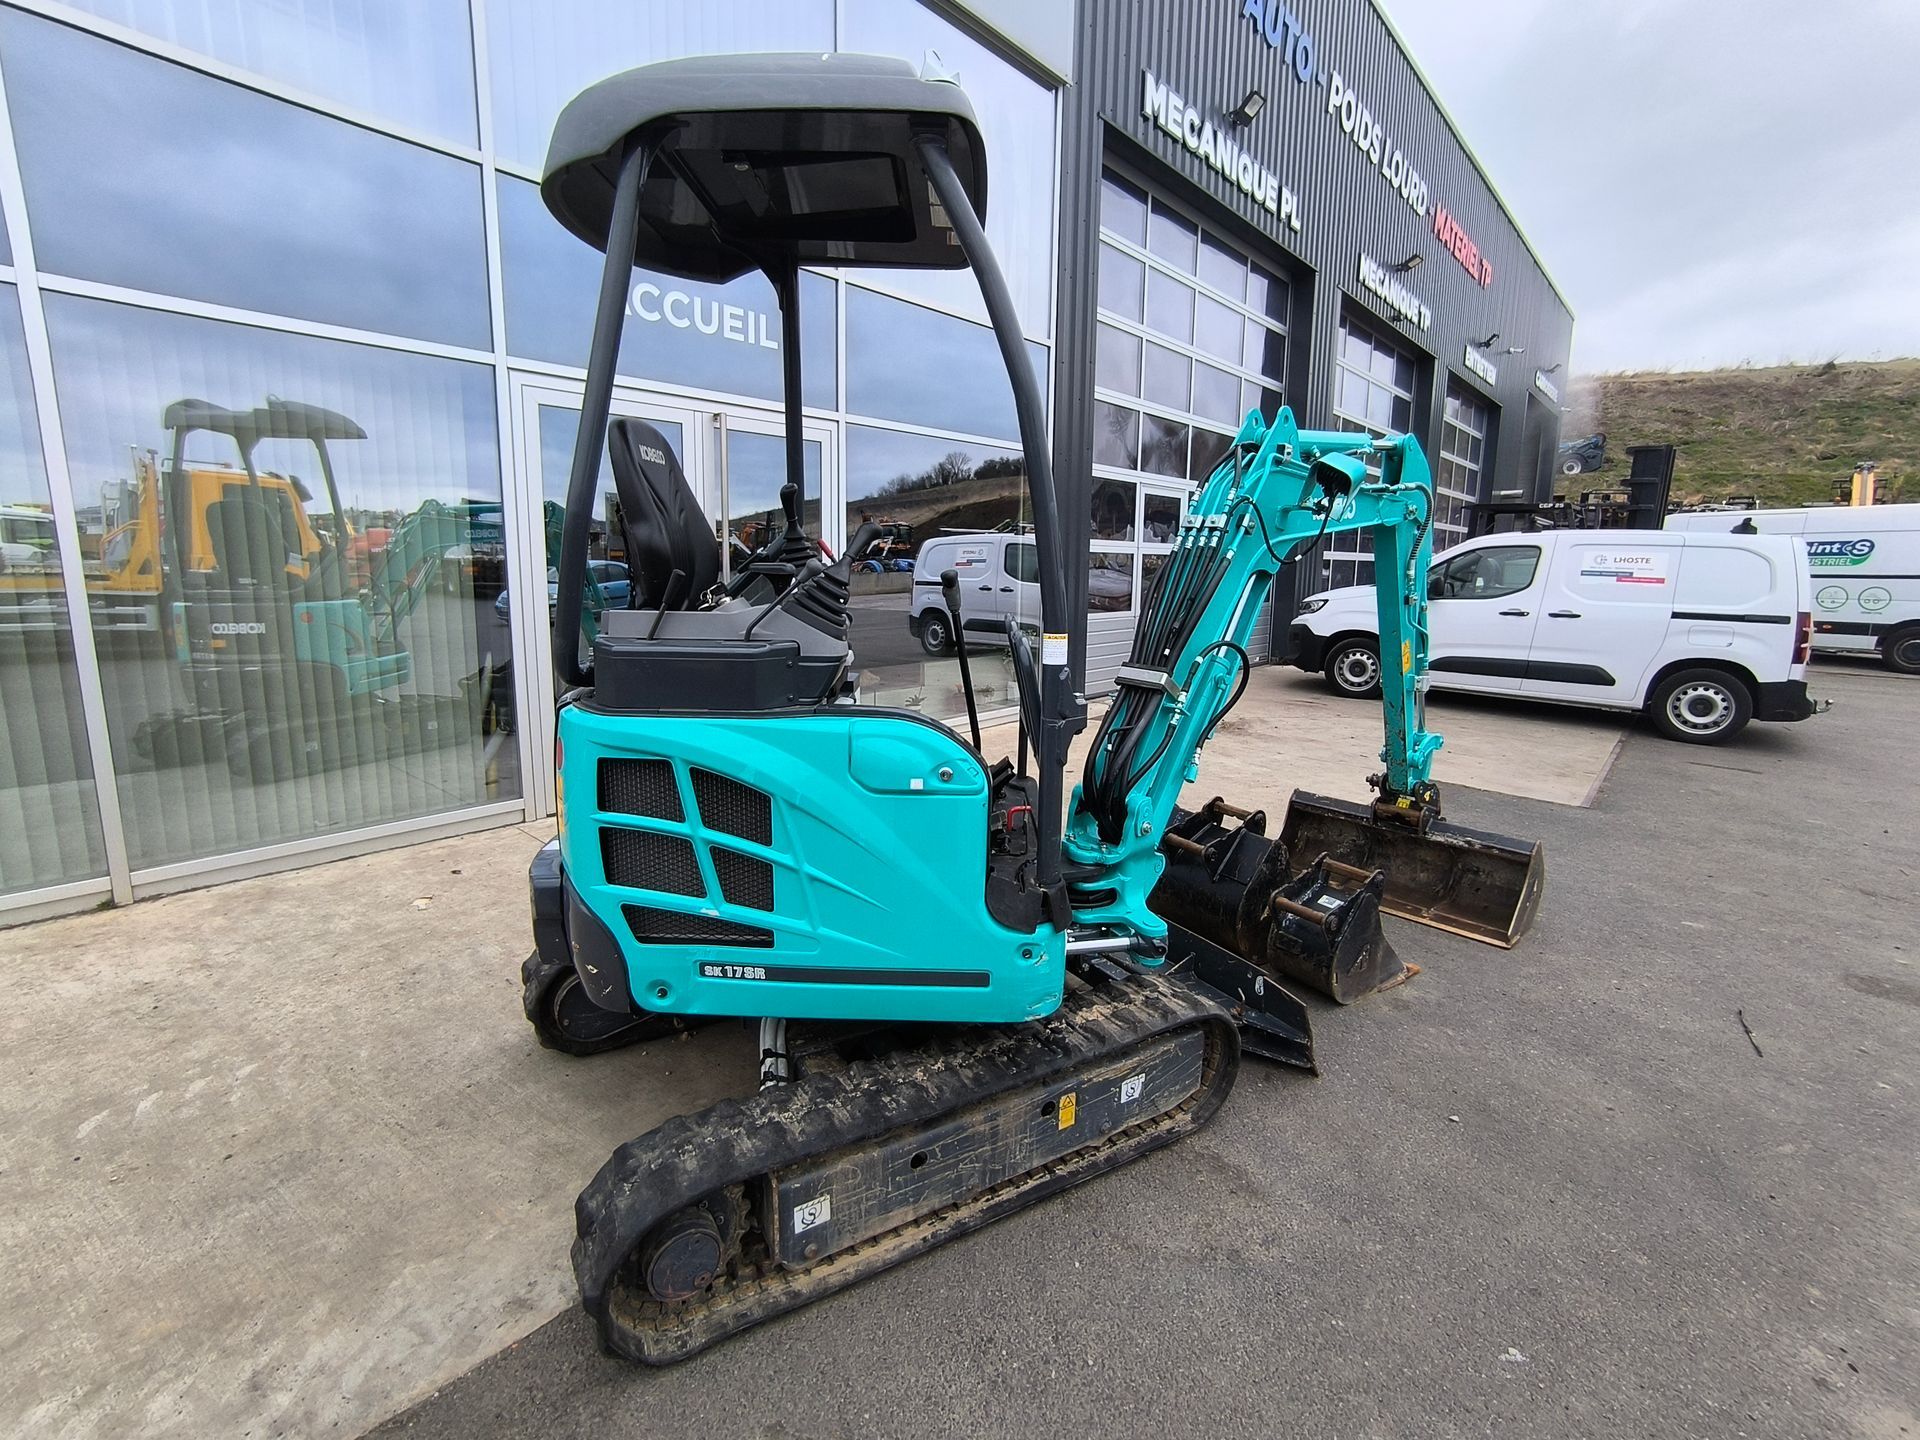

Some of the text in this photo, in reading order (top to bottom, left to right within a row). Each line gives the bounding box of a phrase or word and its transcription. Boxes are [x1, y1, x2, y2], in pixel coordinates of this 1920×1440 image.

[1142, 69, 1301, 233] MECANIQUE PL
[1327, 70, 1383, 165] POIDS
[1381, 137, 1428, 217] LOURD
[1433, 202, 1480, 281] MATERIEL
[1479, 257, 1493, 290] TP
[1358, 251, 1431, 333] MECANIQUE TP
[1613, 556, 1653, 565] LHOSTE
